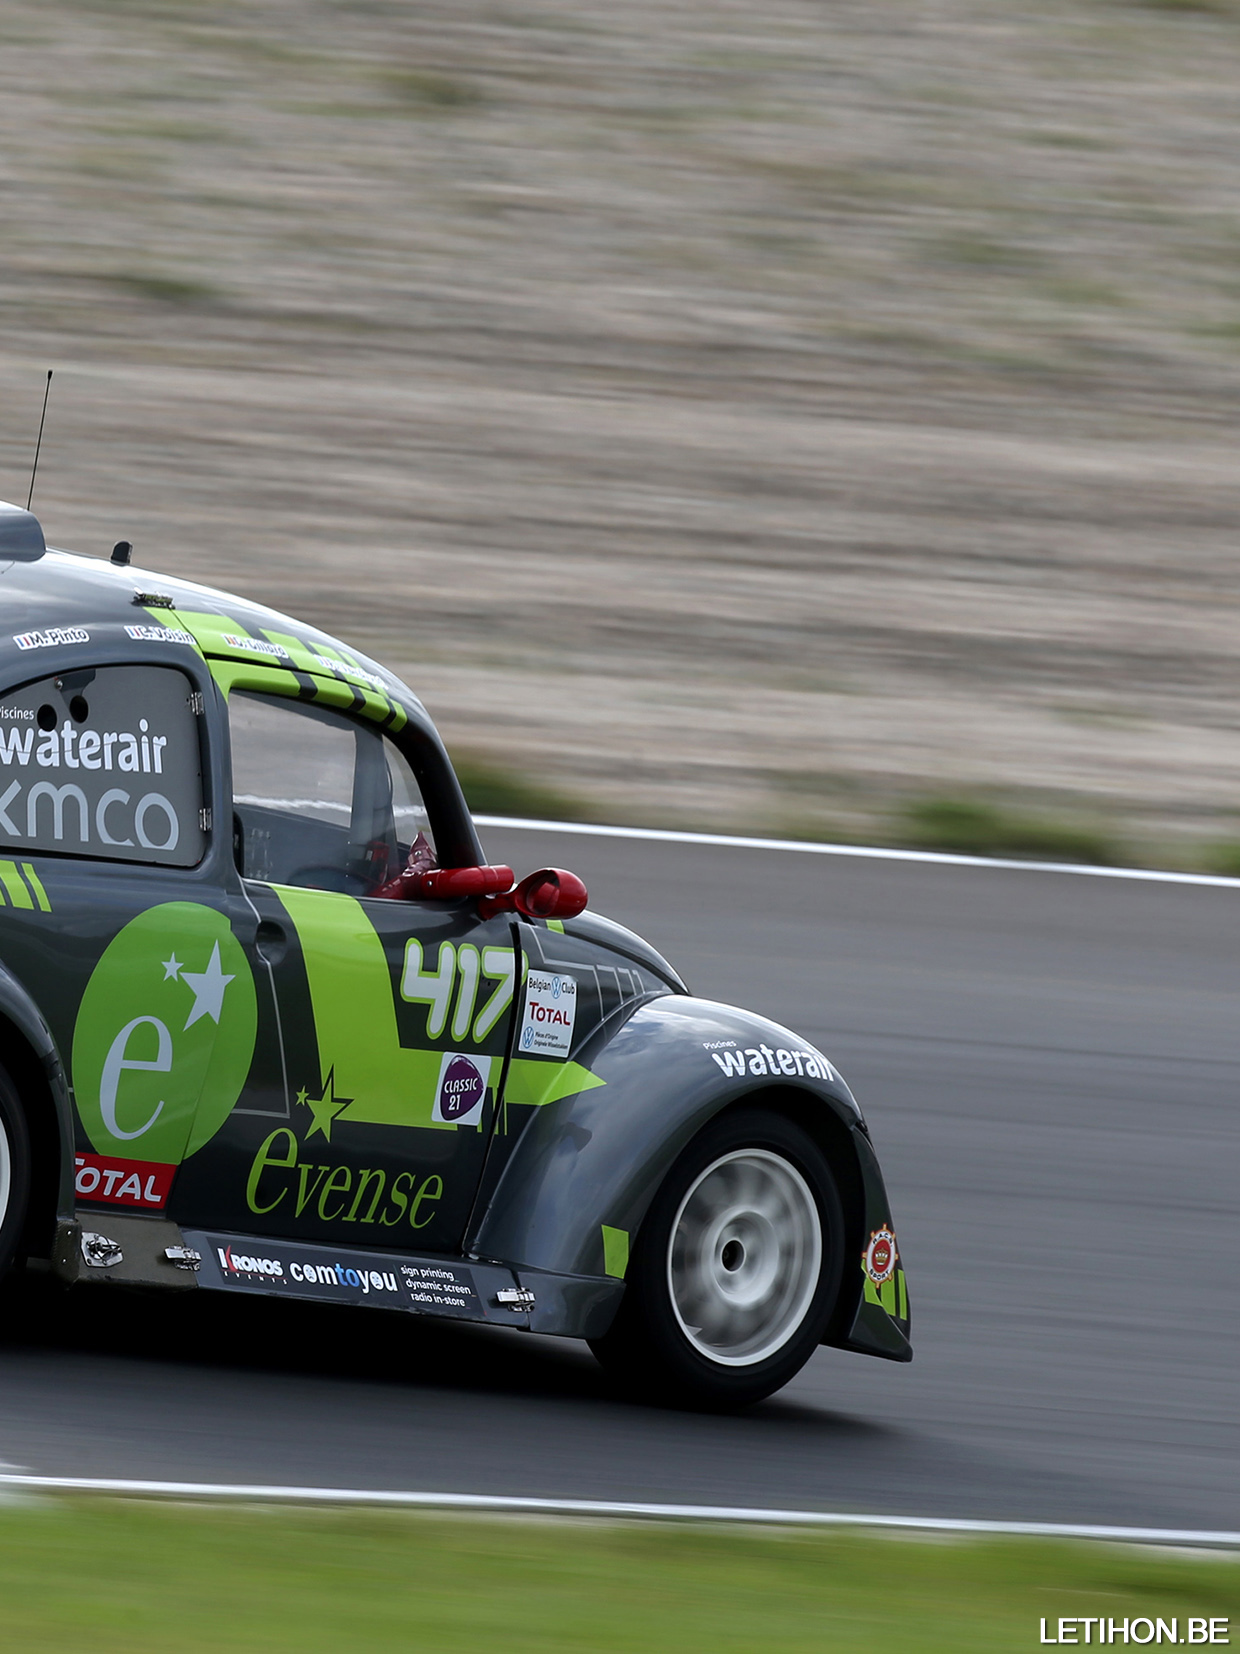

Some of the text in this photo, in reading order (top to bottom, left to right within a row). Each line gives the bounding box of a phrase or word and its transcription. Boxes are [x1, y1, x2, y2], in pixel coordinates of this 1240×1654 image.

[48, 629, 87, 644] Pinto
[401, 938, 529, 1044] 417
[528, 976, 551, 993] Belgian
[561, 982, 575, 995] Club
[529, 1001, 571, 1026] TOTAL
[702, 1040, 737, 1051] Piscines
[443, 1076, 479, 1094] CLASSIC
[448, 1094, 461, 1111] 21
[246, 1127, 443, 1229] evense
[217, 1245, 284, 1276] KRONOS
[289, 1261, 398, 1294] comtoyou
[400, 1264, 455, 1282] sign printing
[405, 1278, 472, 1295] dynamic screen
[410, 1292, 466, 1307] radio in-store
